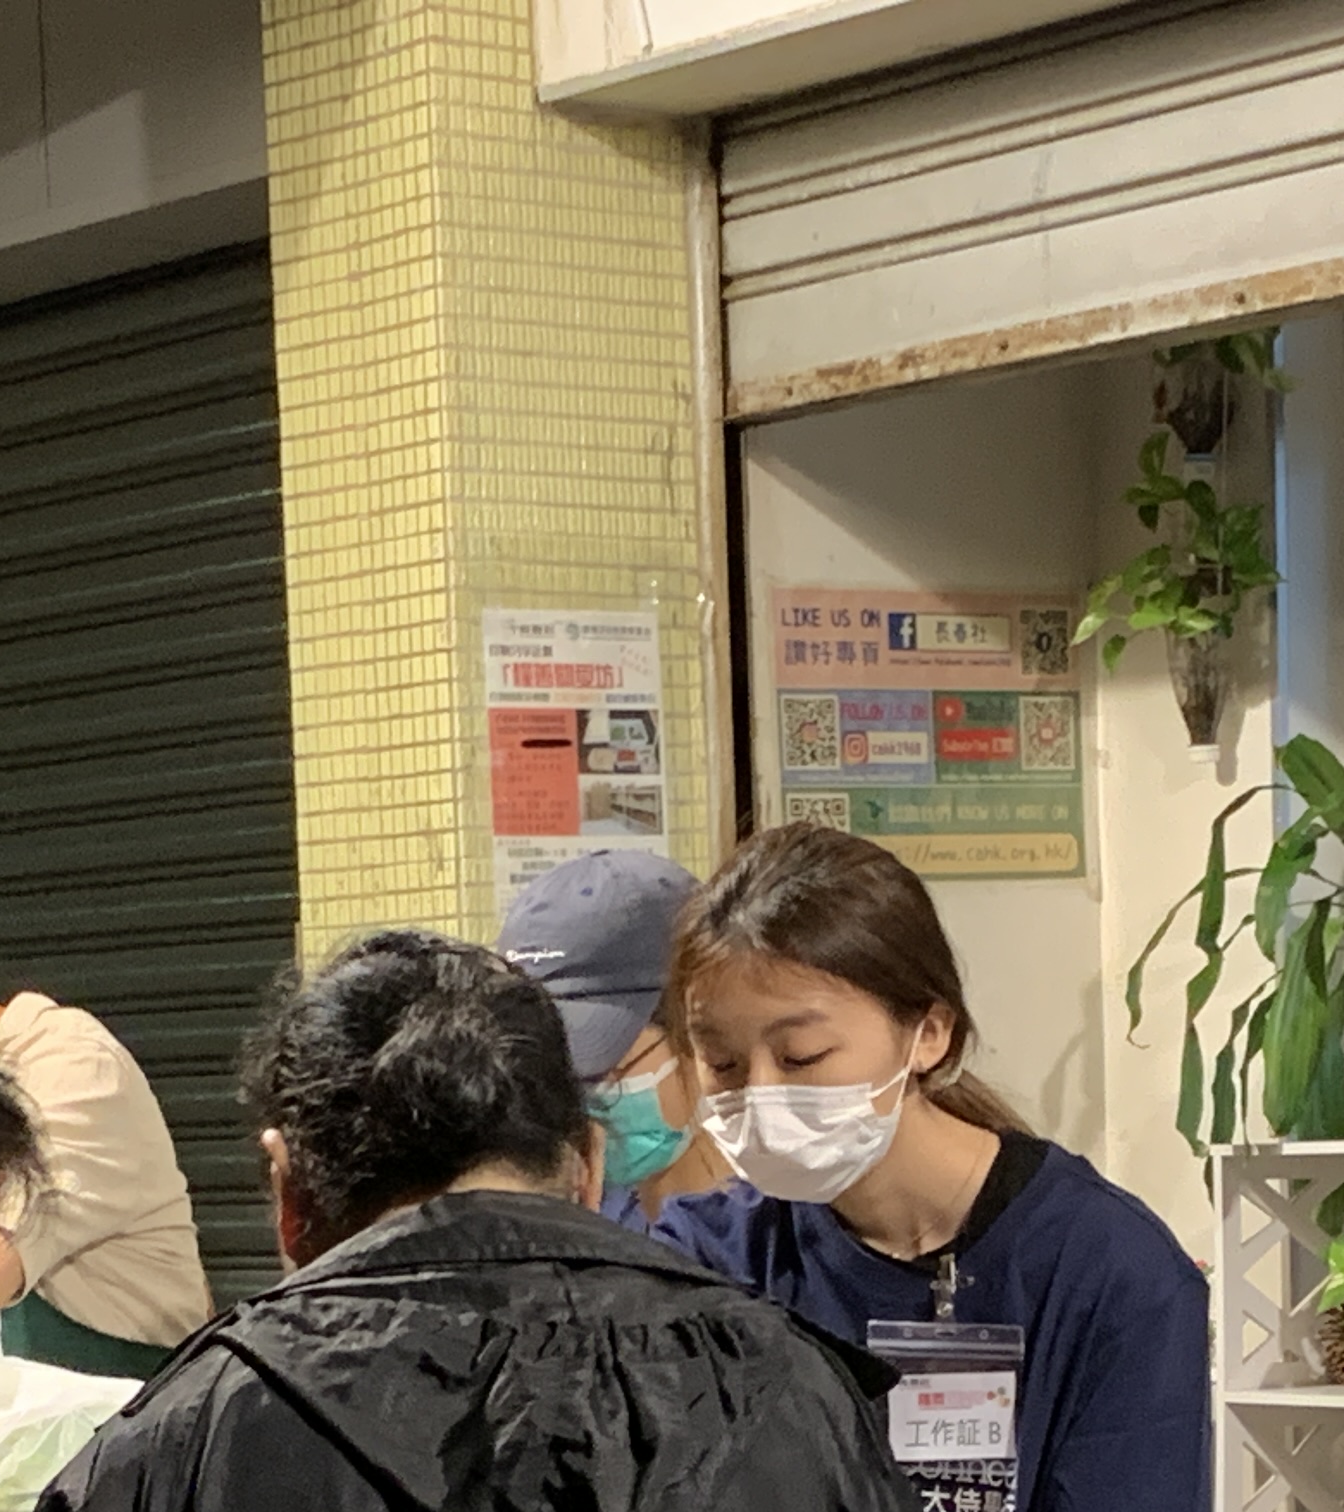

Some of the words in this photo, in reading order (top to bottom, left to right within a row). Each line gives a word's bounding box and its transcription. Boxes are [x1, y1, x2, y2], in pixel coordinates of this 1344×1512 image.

[781, 608, 822, 627] LIKE
[831, 608, 851, 627] US
[860, 610, 881, 627] ON
[935, 621, 987, 643] 長春社
[784, 639, 880, 666] 讚好專頁
[905, 1417, 981, 1447] 工作証
[988, 1421, 1001, 1444] B
